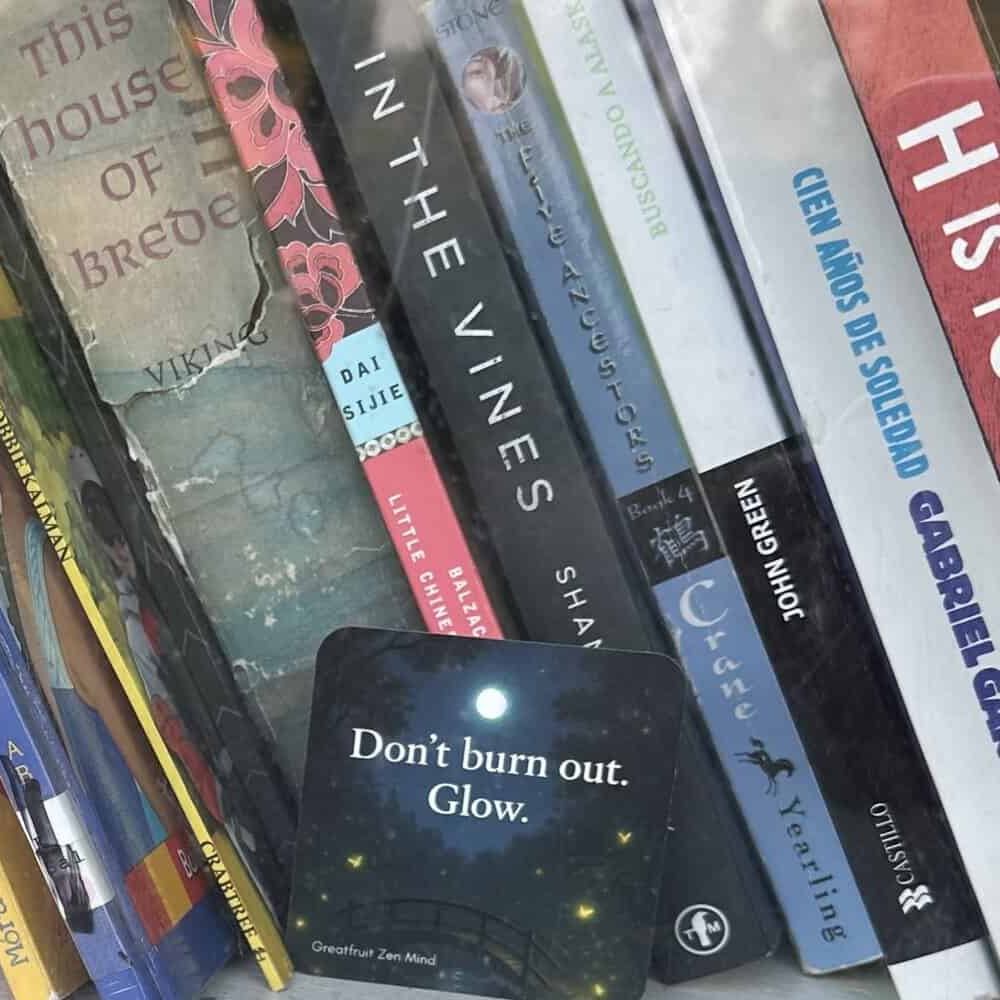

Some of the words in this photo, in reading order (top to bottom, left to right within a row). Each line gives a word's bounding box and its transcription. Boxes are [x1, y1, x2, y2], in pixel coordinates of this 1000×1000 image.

[19, 1, 135, 79] This
[100, 147, 163, 202] OF
[602, 103, 671, 240] BUSCANDO
[792, 167, 837, 236] CIEN
[353, 51, 405, 121] IN
[388, 136, 466, 279] THE
[453, 302, 554, 514] VINES
[816, 238, 871, 314] AÑOS
[144, 320, 269, 388] VIKING
[341, 355, 381, 385] DAI
[559, 260, 655, 474] ANCESTORS
[843, 313, 884, 357] DE
[343, 383, 404, 421] SIJIE
[859, 355, 931, 481] SOLEDAD
[20, 471, 73, 564] KALMAN
[388, 492, 426, 563] LITTLE
[627, 486, 674, 520] Book
[677, 485, 694, 503] 4
[733, 477, 779, 556] GREEN
[448, 566, 487, 637] BALZAC
[764, 558, 805, 622] JOHN
[908, 489, 975, 668] GABRIEL
[678, 579, 760, 721] Crane
[349, 727, 450, 766] Don't
[461, 736, 547, 777] burn
[558, 755, 629, 786] out.
[428, 783, 529, 824] Glow.
[776, 793, 848, 944] Yearling
[869, 801, 916, 887] CASTILLO
[201, 840, 256, 941] CRABTREE
[311, 940, 374, 959] Greatfruit
[377, 948, 401, 961] Zen
[404, 951, 438, 967] Mind
